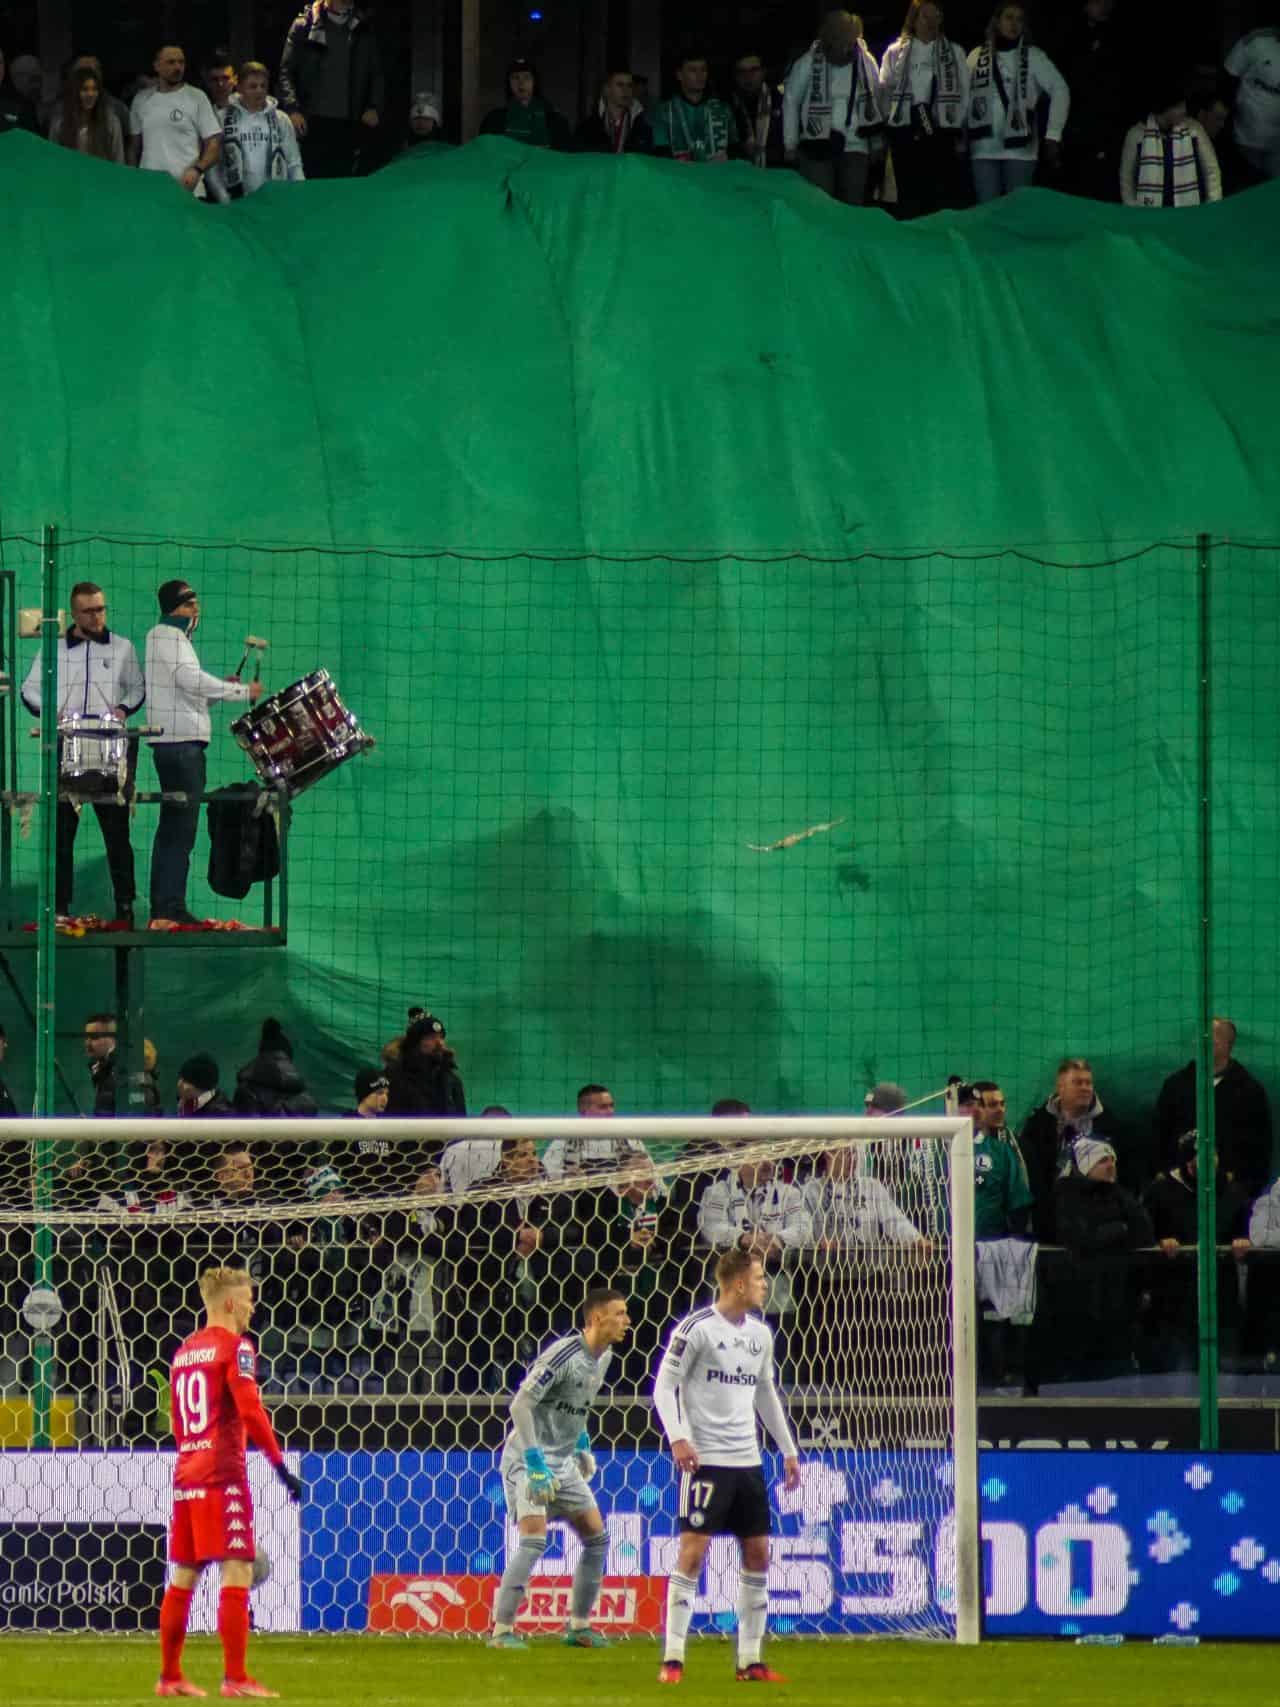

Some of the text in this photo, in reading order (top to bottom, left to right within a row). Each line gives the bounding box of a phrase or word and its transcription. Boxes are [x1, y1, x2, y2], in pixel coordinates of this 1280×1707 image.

[707, 1369, 757, 1386] Plus50
[176, 1371, 209, 1436] 19
[691, 1482, 713, 1508] 17
[57, 1579, 128, 1605] Polski
